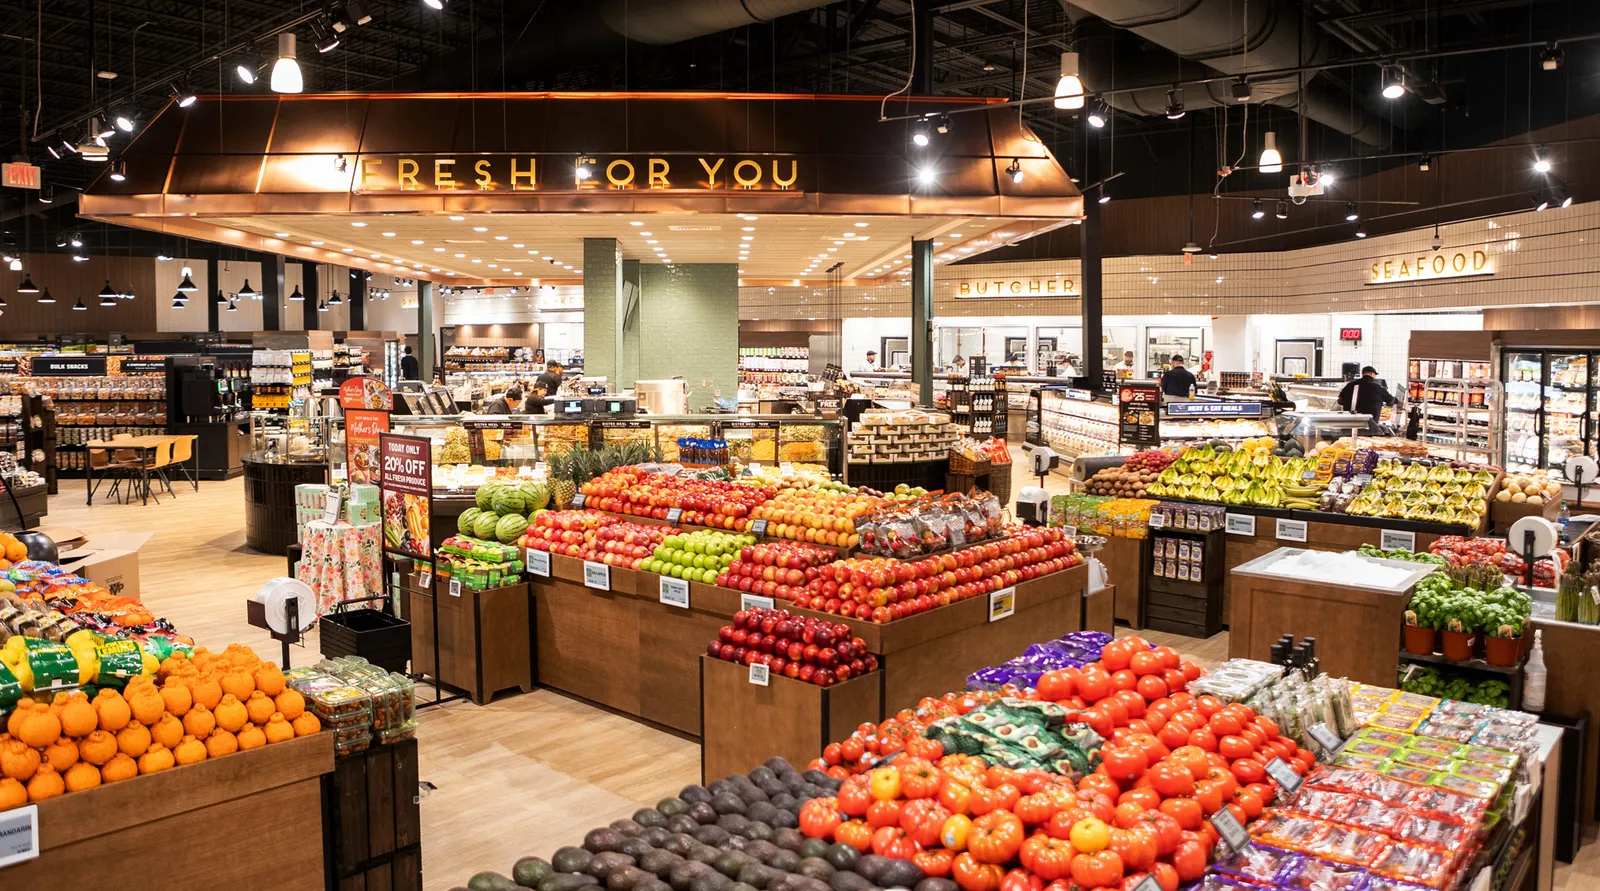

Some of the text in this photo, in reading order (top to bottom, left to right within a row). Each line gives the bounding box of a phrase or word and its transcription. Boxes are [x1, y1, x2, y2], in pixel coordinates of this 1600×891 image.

[10, 164, 36, 186] EXIT
[361, 158, 797, 186] FRESH FOR YOU
[1371, 250, 1487, 280] SEAFOOD
[960, 279, 1074, 295] BUTCHER
[388, 442, 420, 455] TODAY ONLY
[384, 455, 426, 476] 20% OFF
[384, 472, 393, 481] ALL
[392, 474, 406, 483] FRESH
[405, 476, 426, 487] PRODUCE
